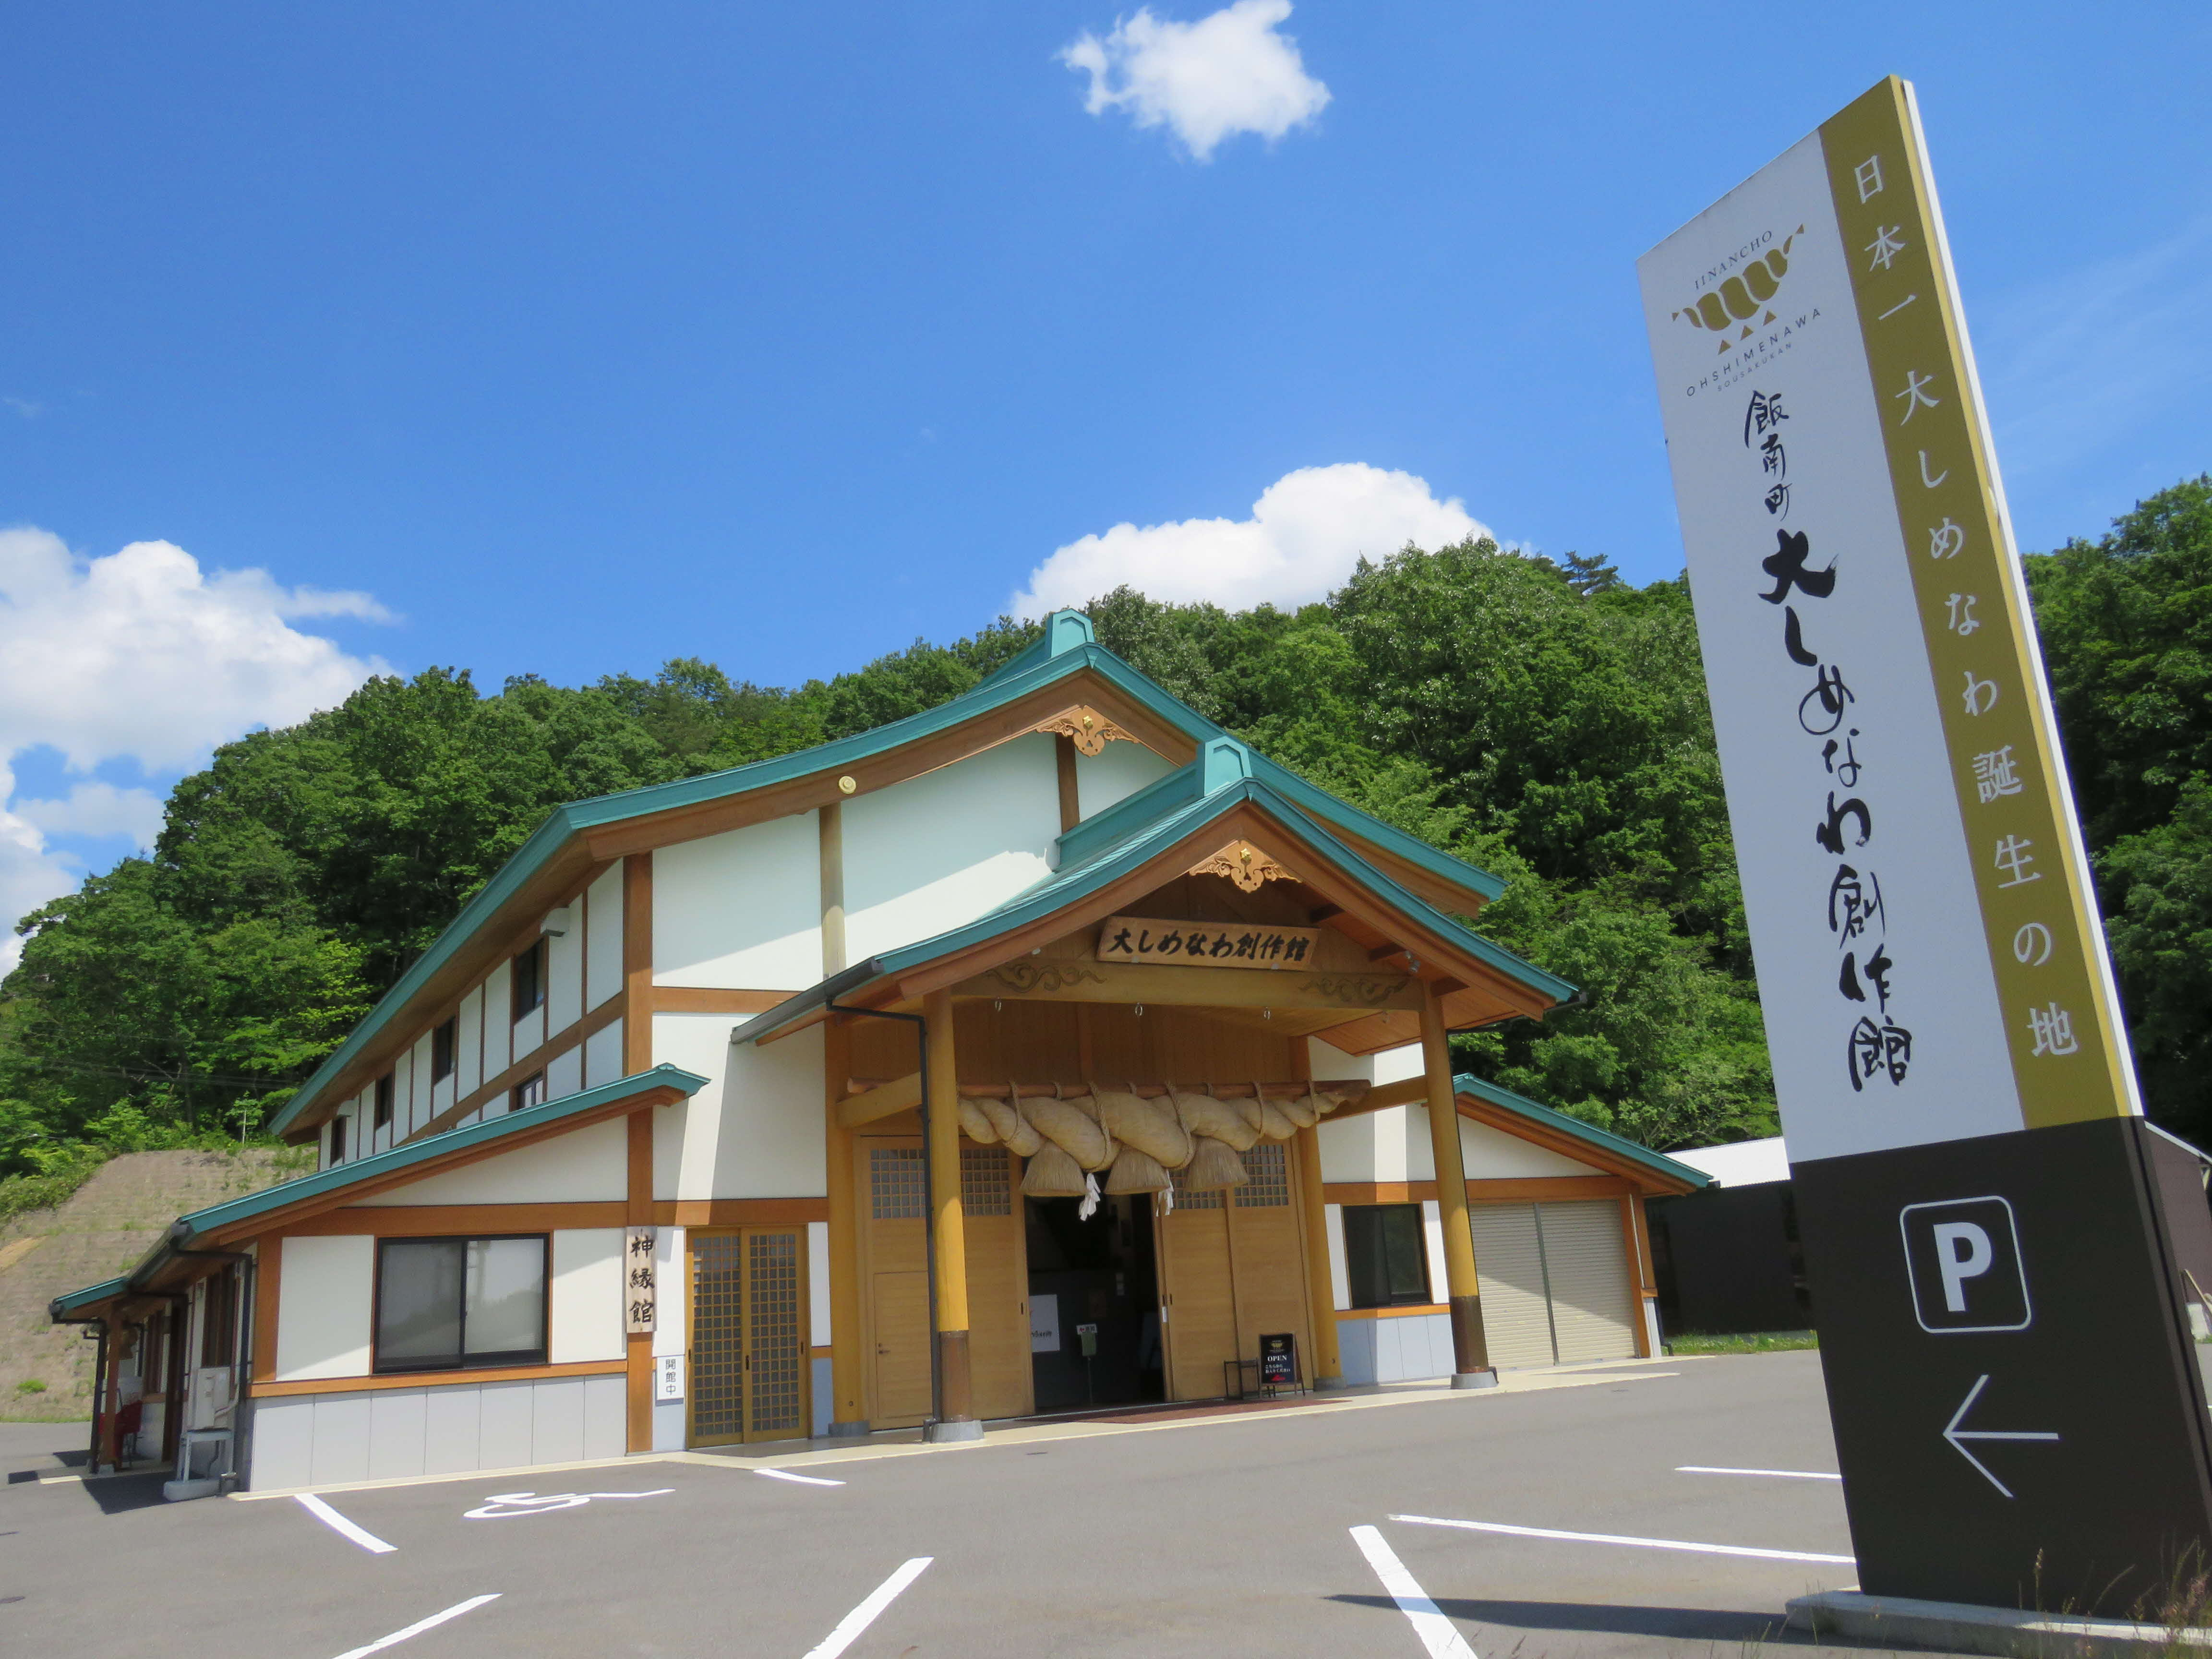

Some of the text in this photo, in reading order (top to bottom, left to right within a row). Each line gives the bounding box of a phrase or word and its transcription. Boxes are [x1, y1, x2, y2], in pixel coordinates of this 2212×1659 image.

[1695, 230, 1772, 289] IINANCHO
[1686, 308, 1821, 397] OHSHIMENAWA
[1717, 343, 1791, 392] SOUSAKUKAN
[1854, 155, 2079, 1057] 日本一大しめなわ誕生の地
[1107, 927, 1310, 962] 大しめなわ創作館
[629, 1235, 655, 1323] 神縁館
[1933, 1222, 1992, 1312] P
[665, 1359, 676, 1395] 開館中
